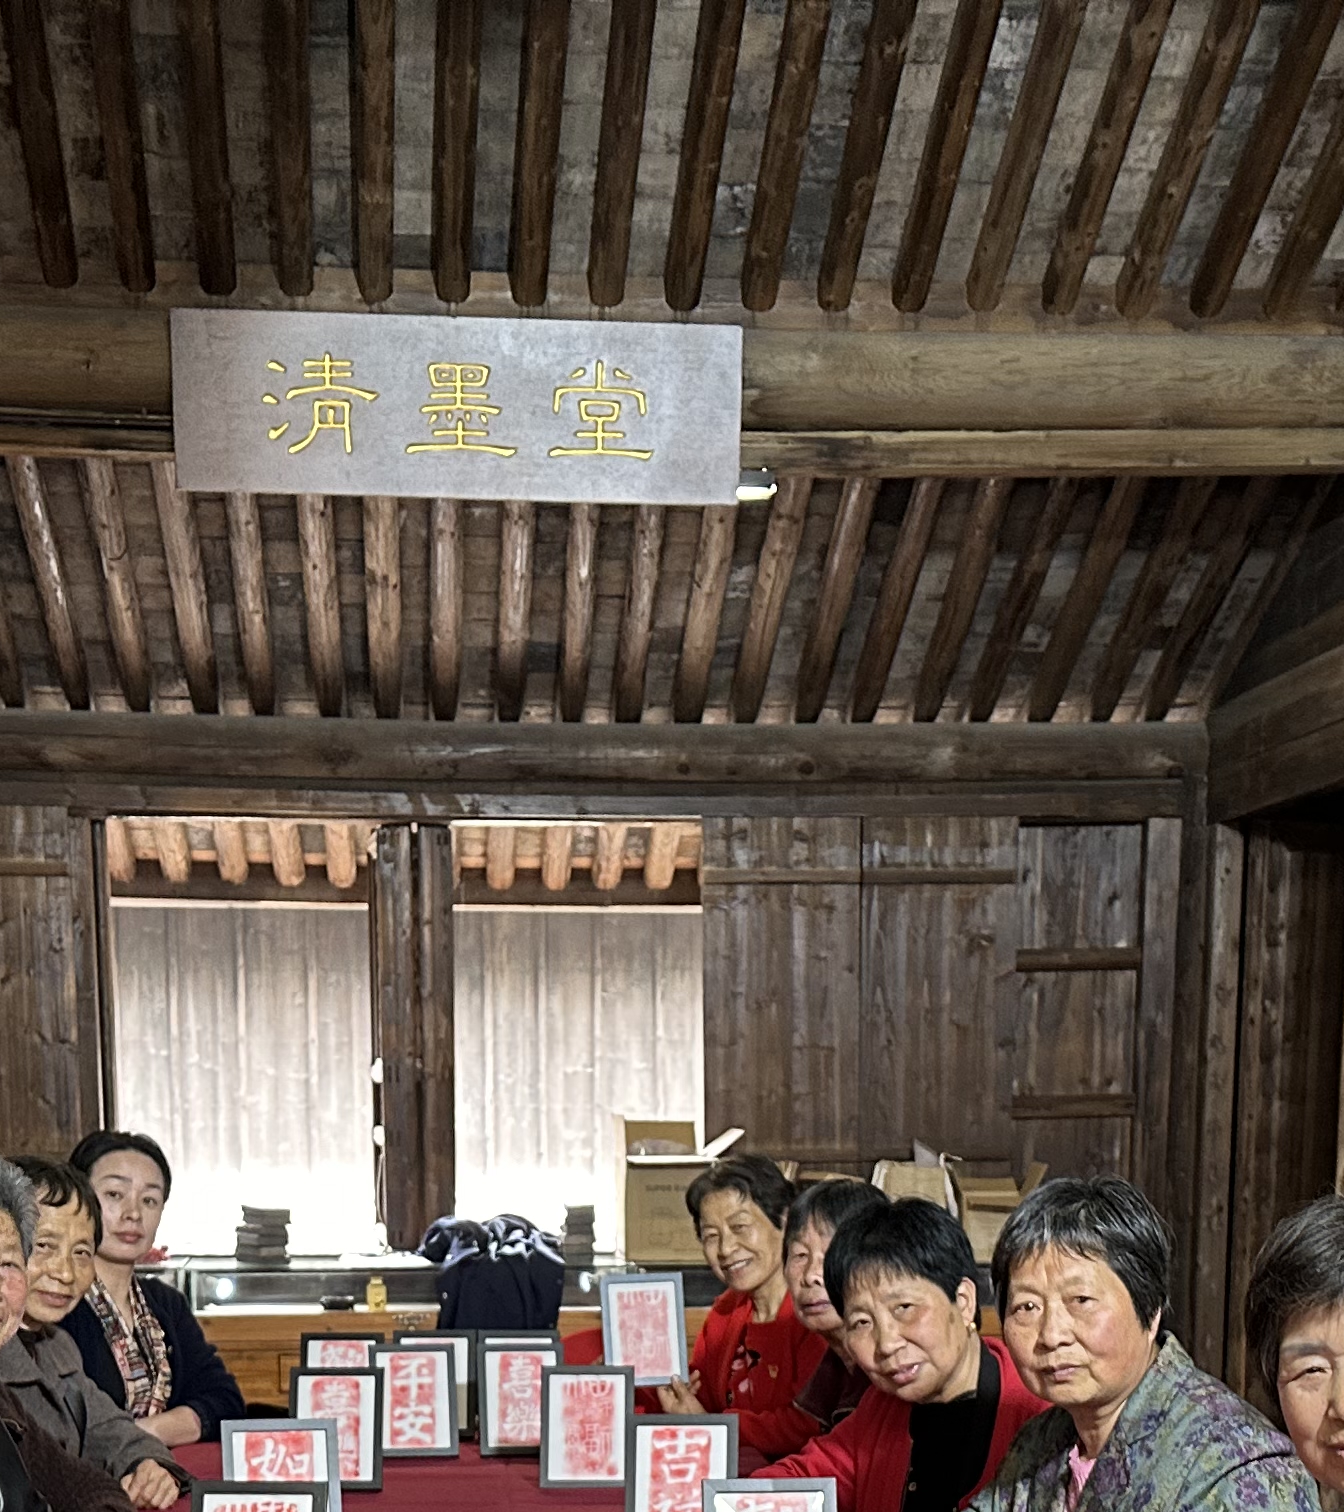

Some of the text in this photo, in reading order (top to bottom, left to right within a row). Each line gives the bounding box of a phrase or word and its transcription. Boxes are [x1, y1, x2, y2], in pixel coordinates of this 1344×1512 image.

[262, 352, 654, 459] 清墨堂
[393, 1356, 434, 1443] 平安
